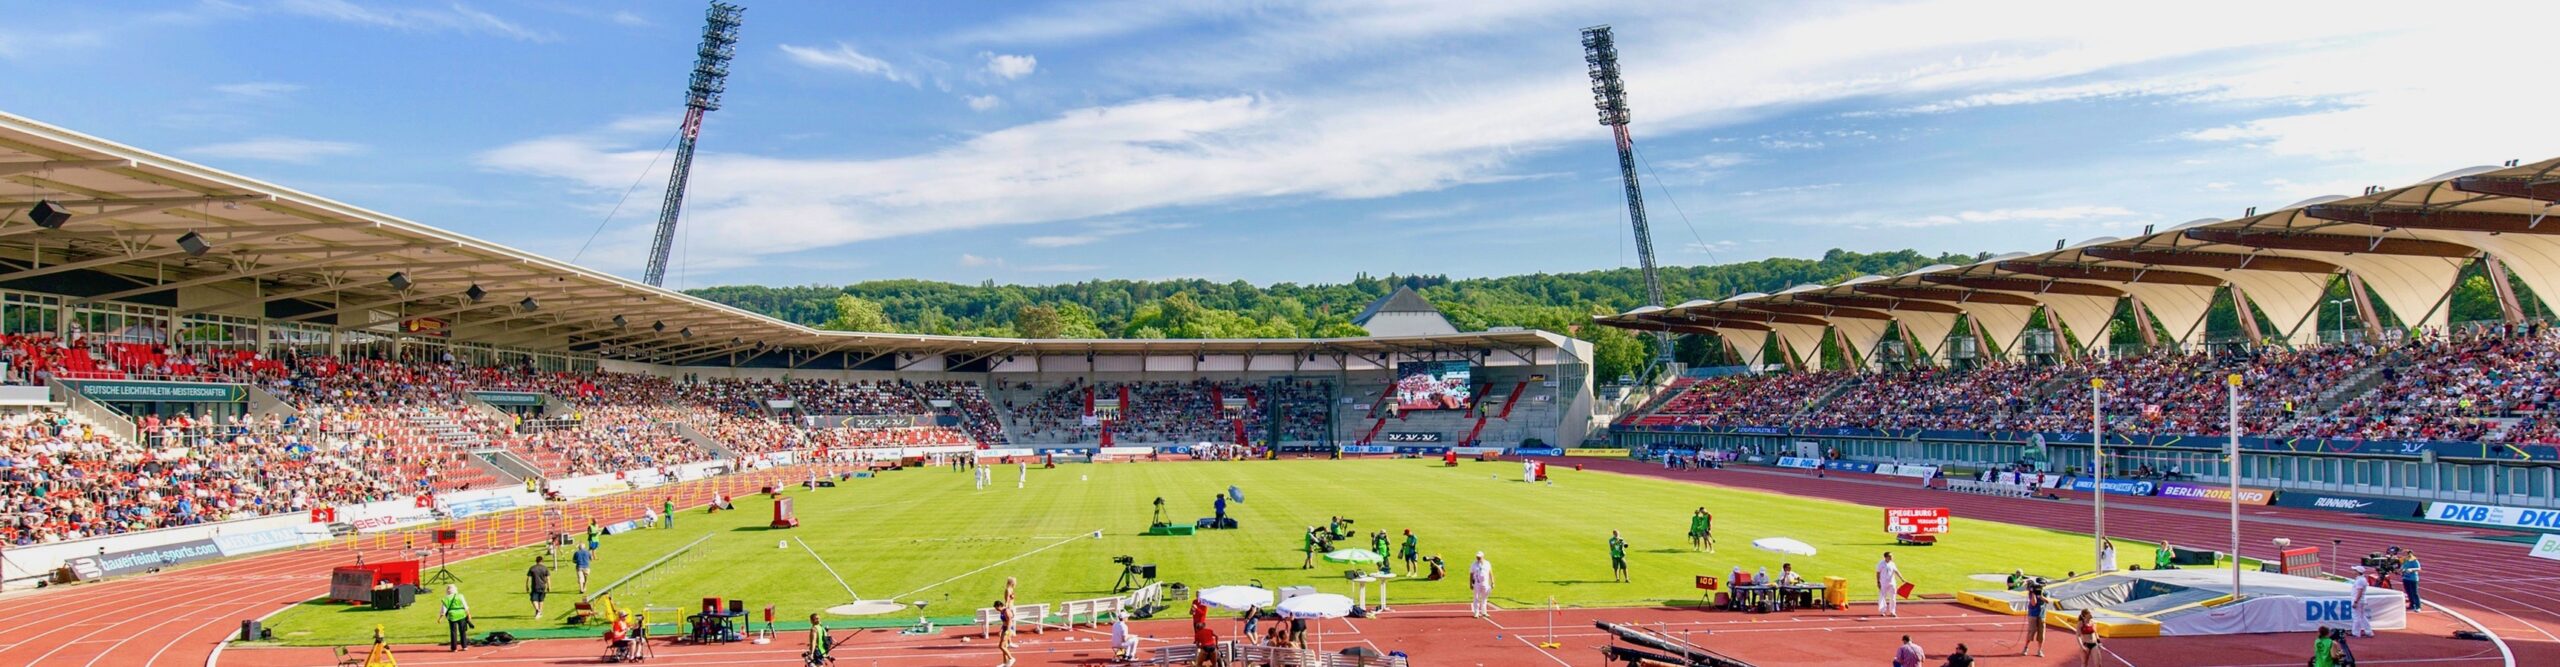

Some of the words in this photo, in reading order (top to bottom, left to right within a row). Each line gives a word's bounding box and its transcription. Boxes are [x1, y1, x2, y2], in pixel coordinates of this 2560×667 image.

[84, 385, 120, 395] DEUTSCHE
[121, 385, 226, 397] LEICHTATHLETIK-MEISTERSCHAFTEN
[2164, 487, 2263, 502] BERLIN2018.NFO
[2314, 497, 2358, 509] RUNNING
[2440, 504, 2489, 522] DKB
[100, 543, 218, 572] bauerfeind-sports.com
[2305, 600, 2352, 621] DKB
